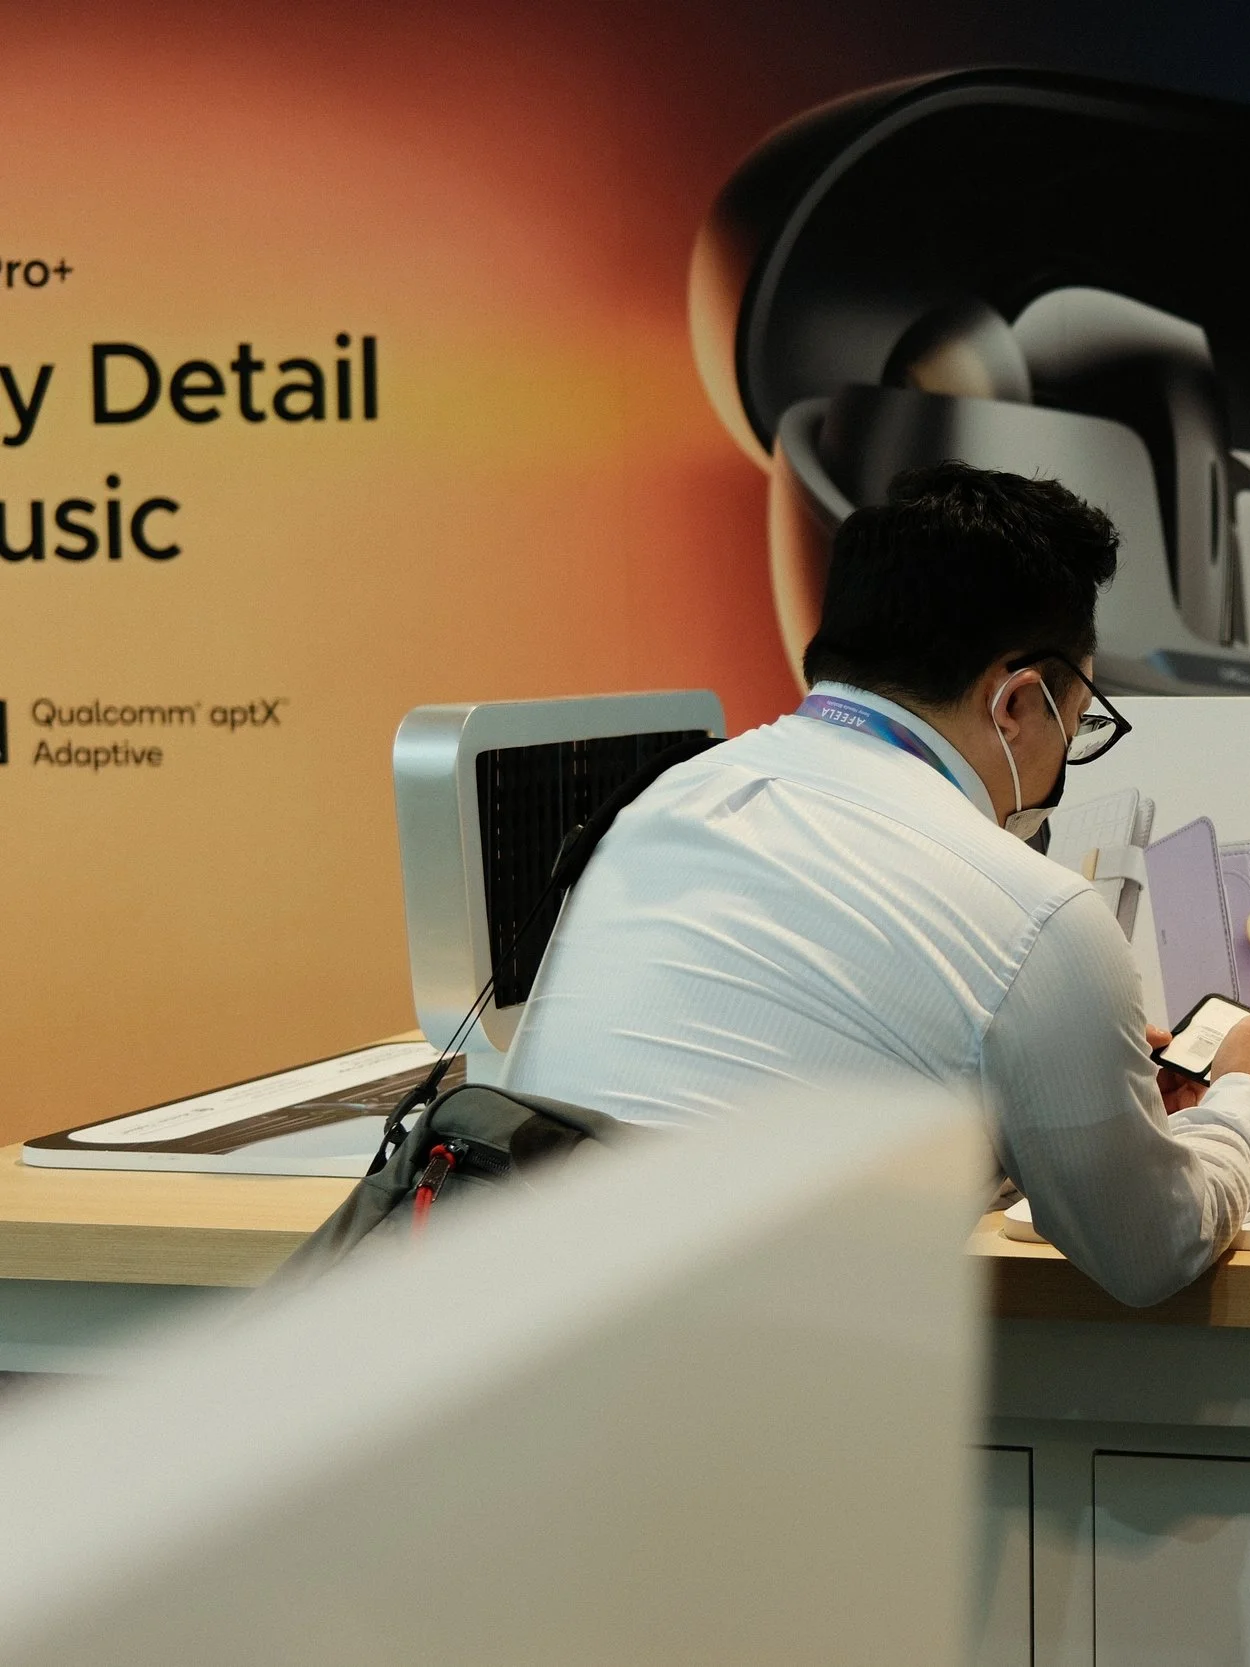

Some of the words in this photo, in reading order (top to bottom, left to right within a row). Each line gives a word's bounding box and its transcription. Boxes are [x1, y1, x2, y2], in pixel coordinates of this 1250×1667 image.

[0, 257, 73, 289] ro+
[91, 331, 378, 424] Detail
[821, 707, 866, 727] AFEELA
[33, 741, 164, 771] Adaptive
